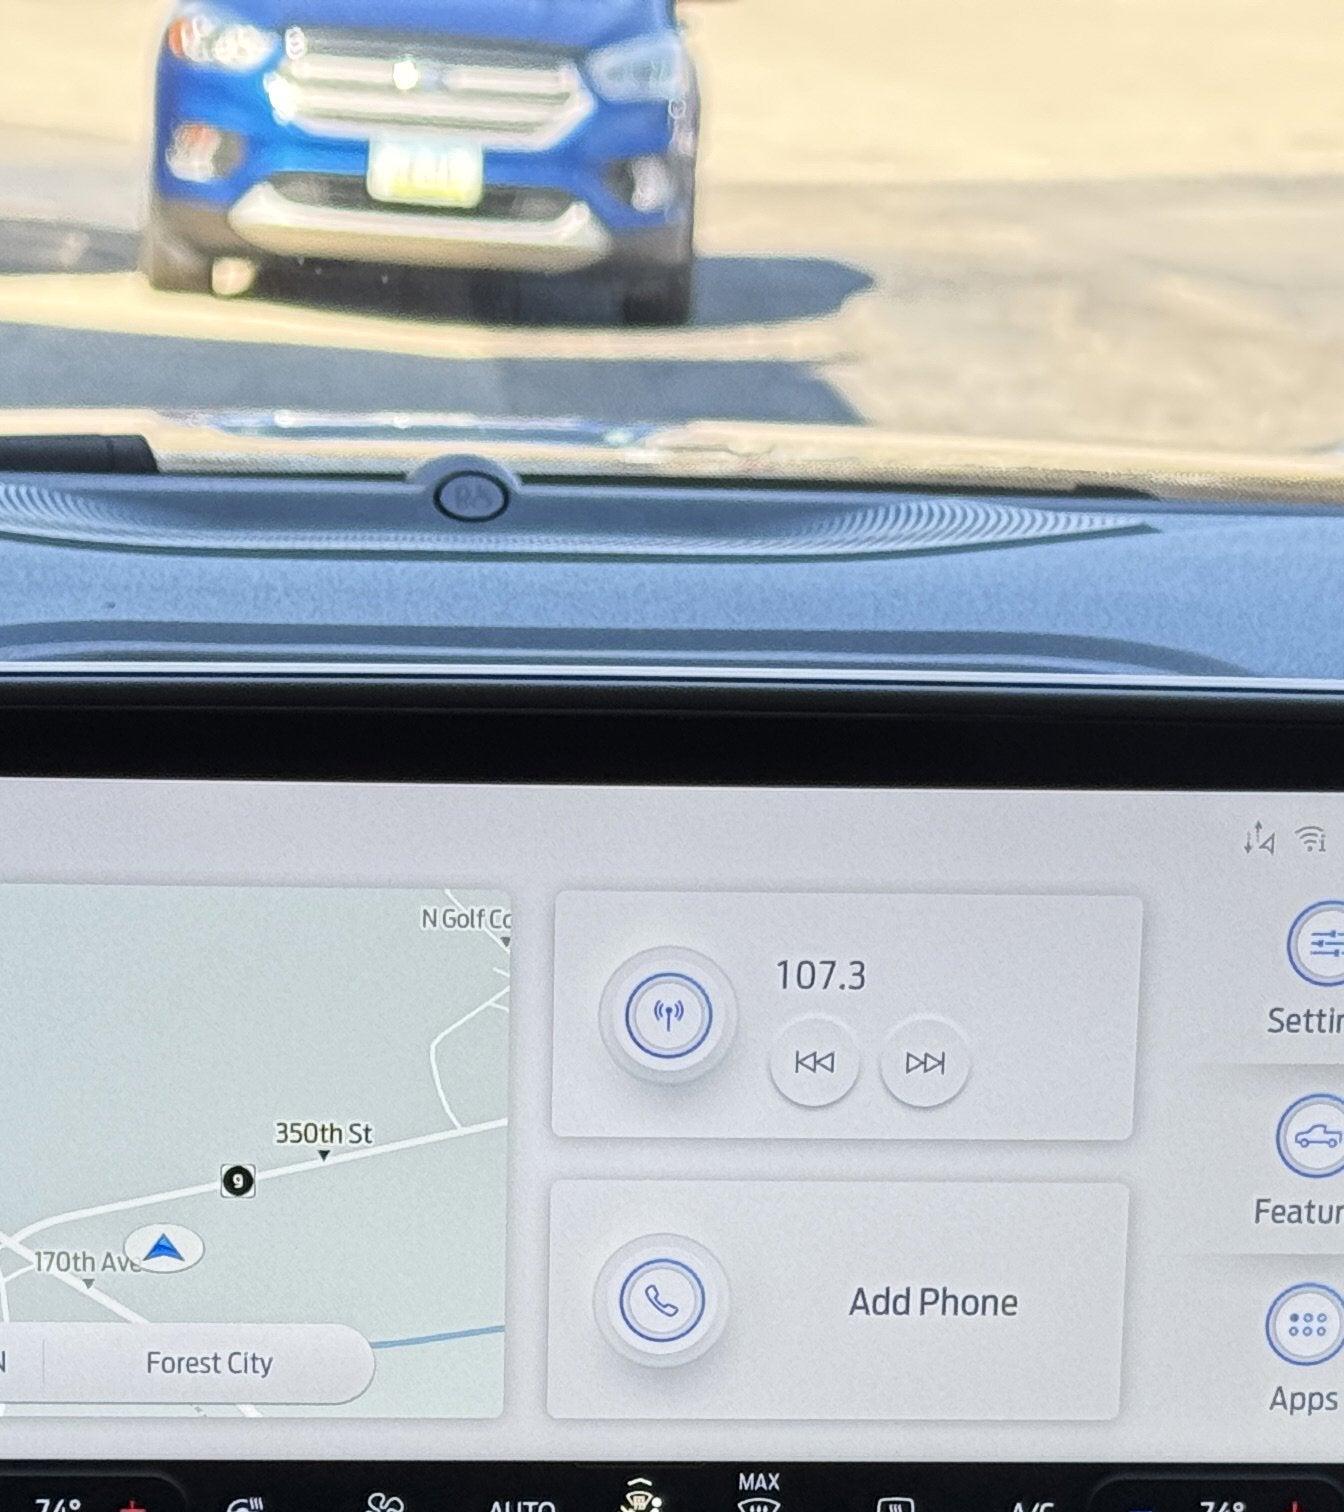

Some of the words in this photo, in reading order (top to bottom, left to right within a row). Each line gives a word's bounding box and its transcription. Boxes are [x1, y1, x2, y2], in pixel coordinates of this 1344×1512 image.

[422, 908, 438, 928] N
[441, 908, 486, 929] Golf
[777, 959, 866, 991] 107.3
[276, 1122, 343, 1144] 350th
[348, 1122, 373, 1144] St
[232, 1173, 244, 1189] 9
[34, 1250, 96, 1273] 170th
[848, 1286, 911, 1316] Add
[919, 1286, 1018, 1317] Phone
[146, 1350, 222, 1375] Forest
[227, 1350, 274, 1379] City
[1269, 1385, 1339, 1417] Apps
[738, 1472, 780, 1491] MAX
